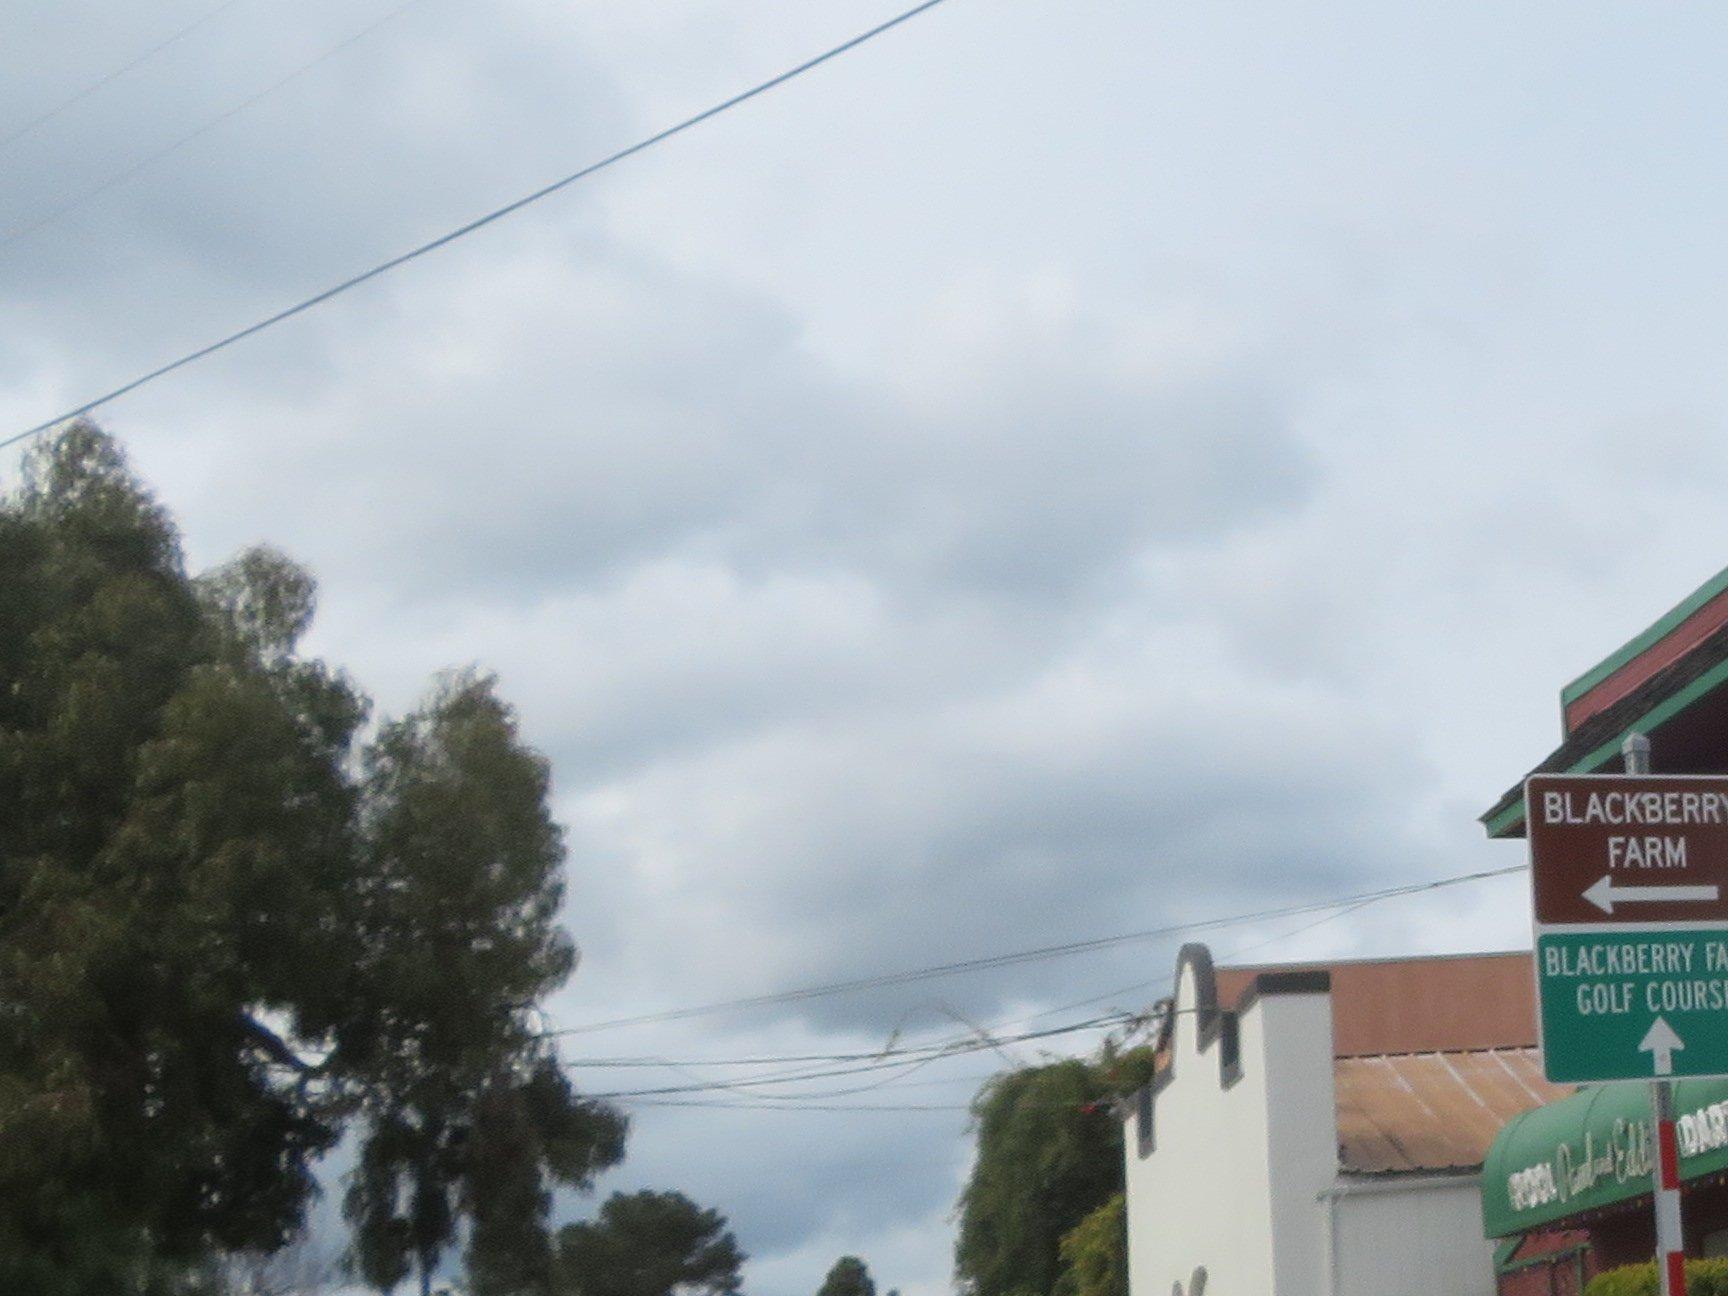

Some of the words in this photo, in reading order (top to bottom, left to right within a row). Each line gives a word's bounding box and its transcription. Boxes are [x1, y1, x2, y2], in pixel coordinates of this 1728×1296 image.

[1608, 836, 1687, 868] FARM
[1545, 943, 1694, 976] BLACKBERRY
[1577, 982, 1635, 1014] GOLF
